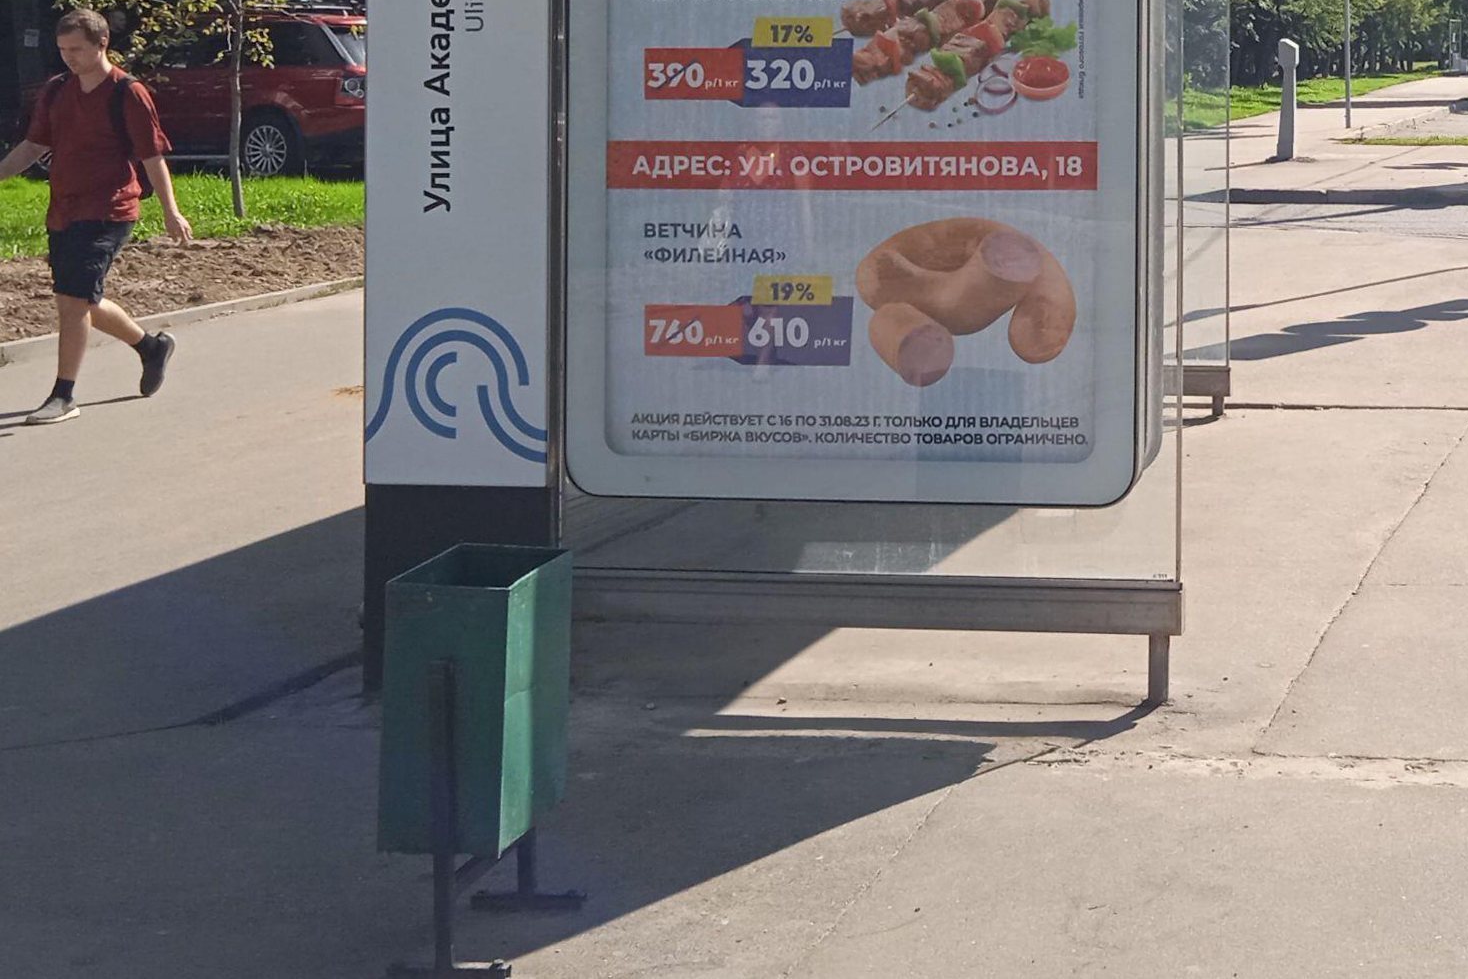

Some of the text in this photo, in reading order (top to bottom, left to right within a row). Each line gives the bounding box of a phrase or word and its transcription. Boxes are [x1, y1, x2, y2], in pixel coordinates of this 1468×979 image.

[770, 24, 813, 43] 17%
[647, 62, 704, 88] 390
[745, 59, 815, 90] 320
[423, 104, 455, 213] Улица
[632, 155, 1083, 180] АДРЕС: УЛ. ОСТРОВИТЯНОВА, 18
[644, 222, 742, 239] ВЕТЧИНА
[644, 244, 786, 264] «ФИЛЕЙНАЯ»
[770, 282, 815, 302] 19%
[748, 317, 809, 348] 610
[632, 413, 680, 426] АКЦИЯ
[683, 412, 764, 427] ДЕЙСТВУЕТ
[766, 414, 778, 426] С
[779, 415, 793, 427] 16
[796, 415, 817, 427] ПО
[819, 415, 871, 428] 31.08.23
[884, 416, 942, 428] ТОЛЬКО
[945, 416, 976, 430] ДЛЯ
[979, 416, 1079, 430] ВЛАДЕЛЬЦЕВ
[632, 430, 1089, 446] КАРТЫ «БИРЖА ВКУСОВ». КОЛИЧЕСТВО ТОВАРОВ ОГРАНИЧЕНО.
